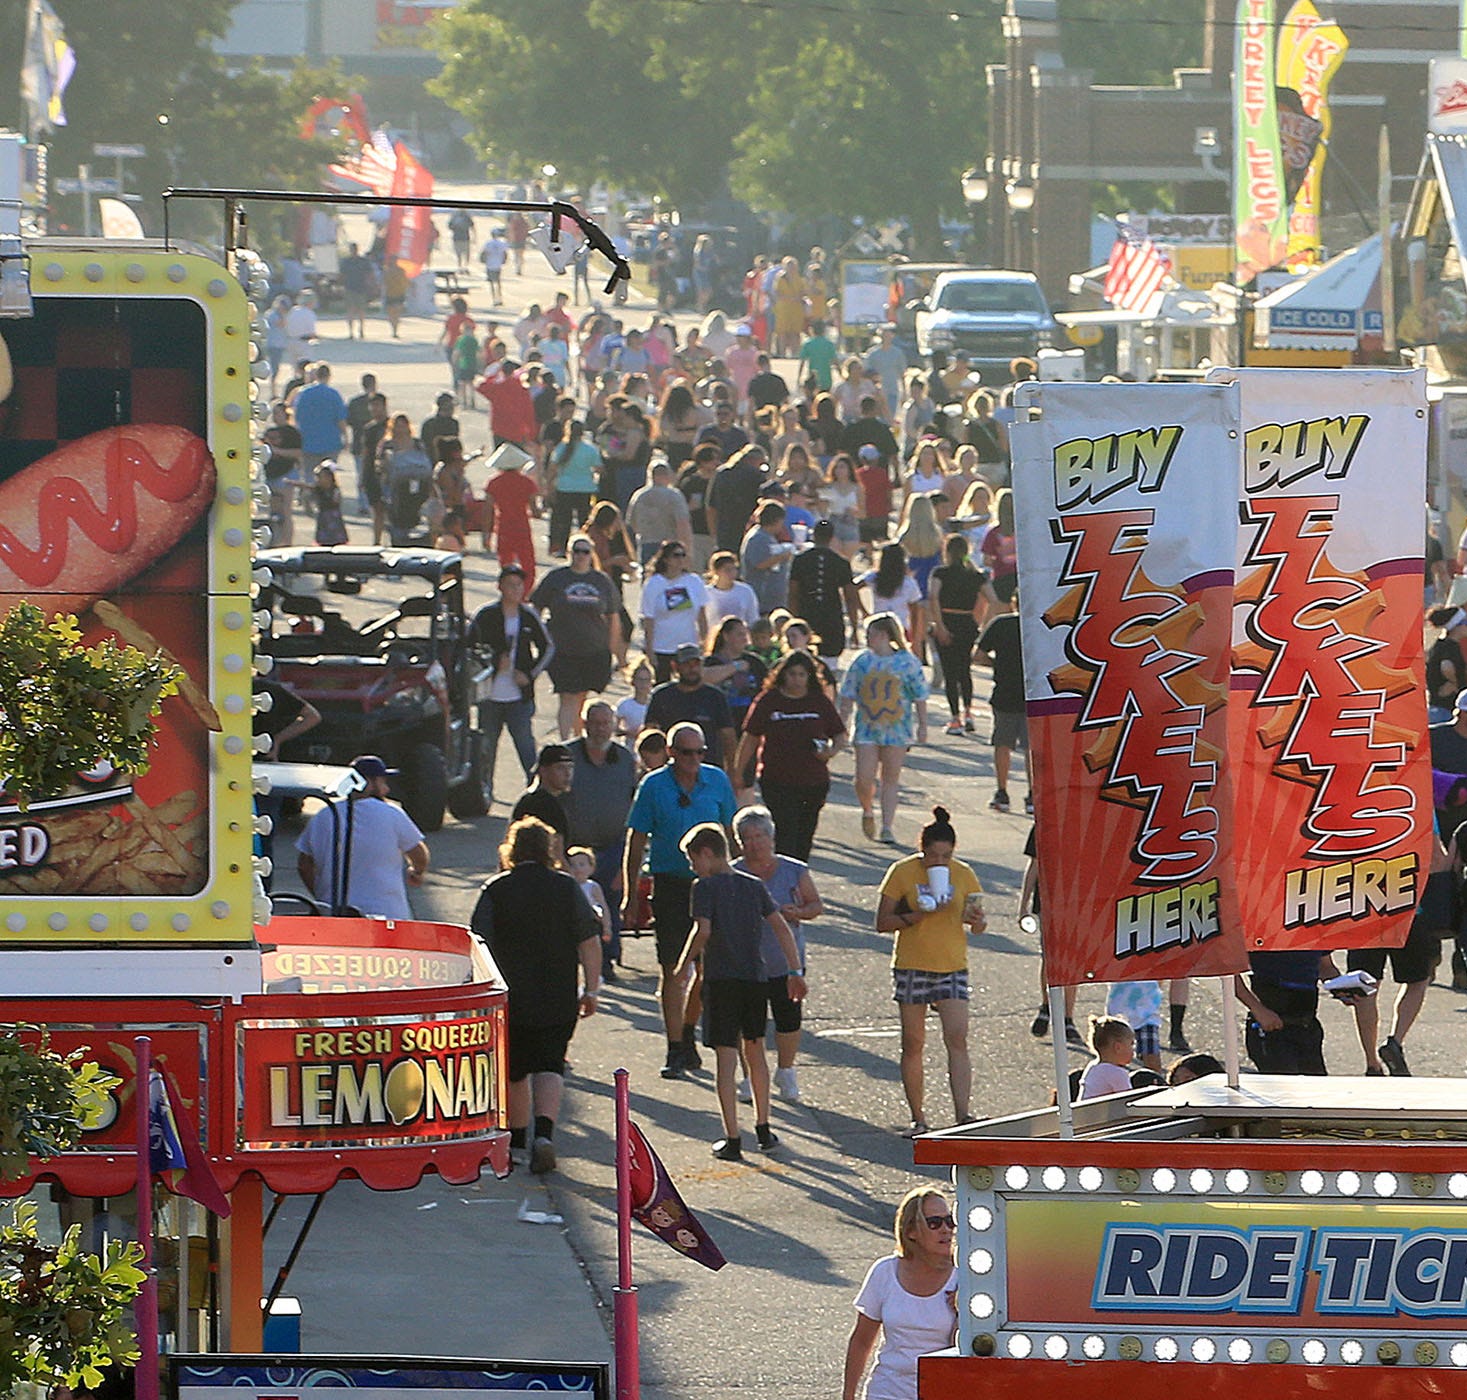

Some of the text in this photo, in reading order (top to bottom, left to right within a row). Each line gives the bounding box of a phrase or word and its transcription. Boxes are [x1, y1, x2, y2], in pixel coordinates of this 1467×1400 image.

[1246, 137, 1281, 224] LEGS
[1275, 311, 1302, 327] ICE
[1306, 310, 1350, 328] COLD
[1054, 426, 1183, 511] BUY
[1244, 415, 1370, 494] BUY
[1049, 508, 1220, 886] TICKETS
[1240, 495, 1418, 860] TICKETS
[1115, 881, 1221, 959] HERE
[1284, 854, 1420, 930] HERE
[295, 1020, 493, 1057] FRESH SQUEEZED
[270, 1057, 497, 1129] LEMONAD
[1096, 1226, 1304, 1308] RIDE
